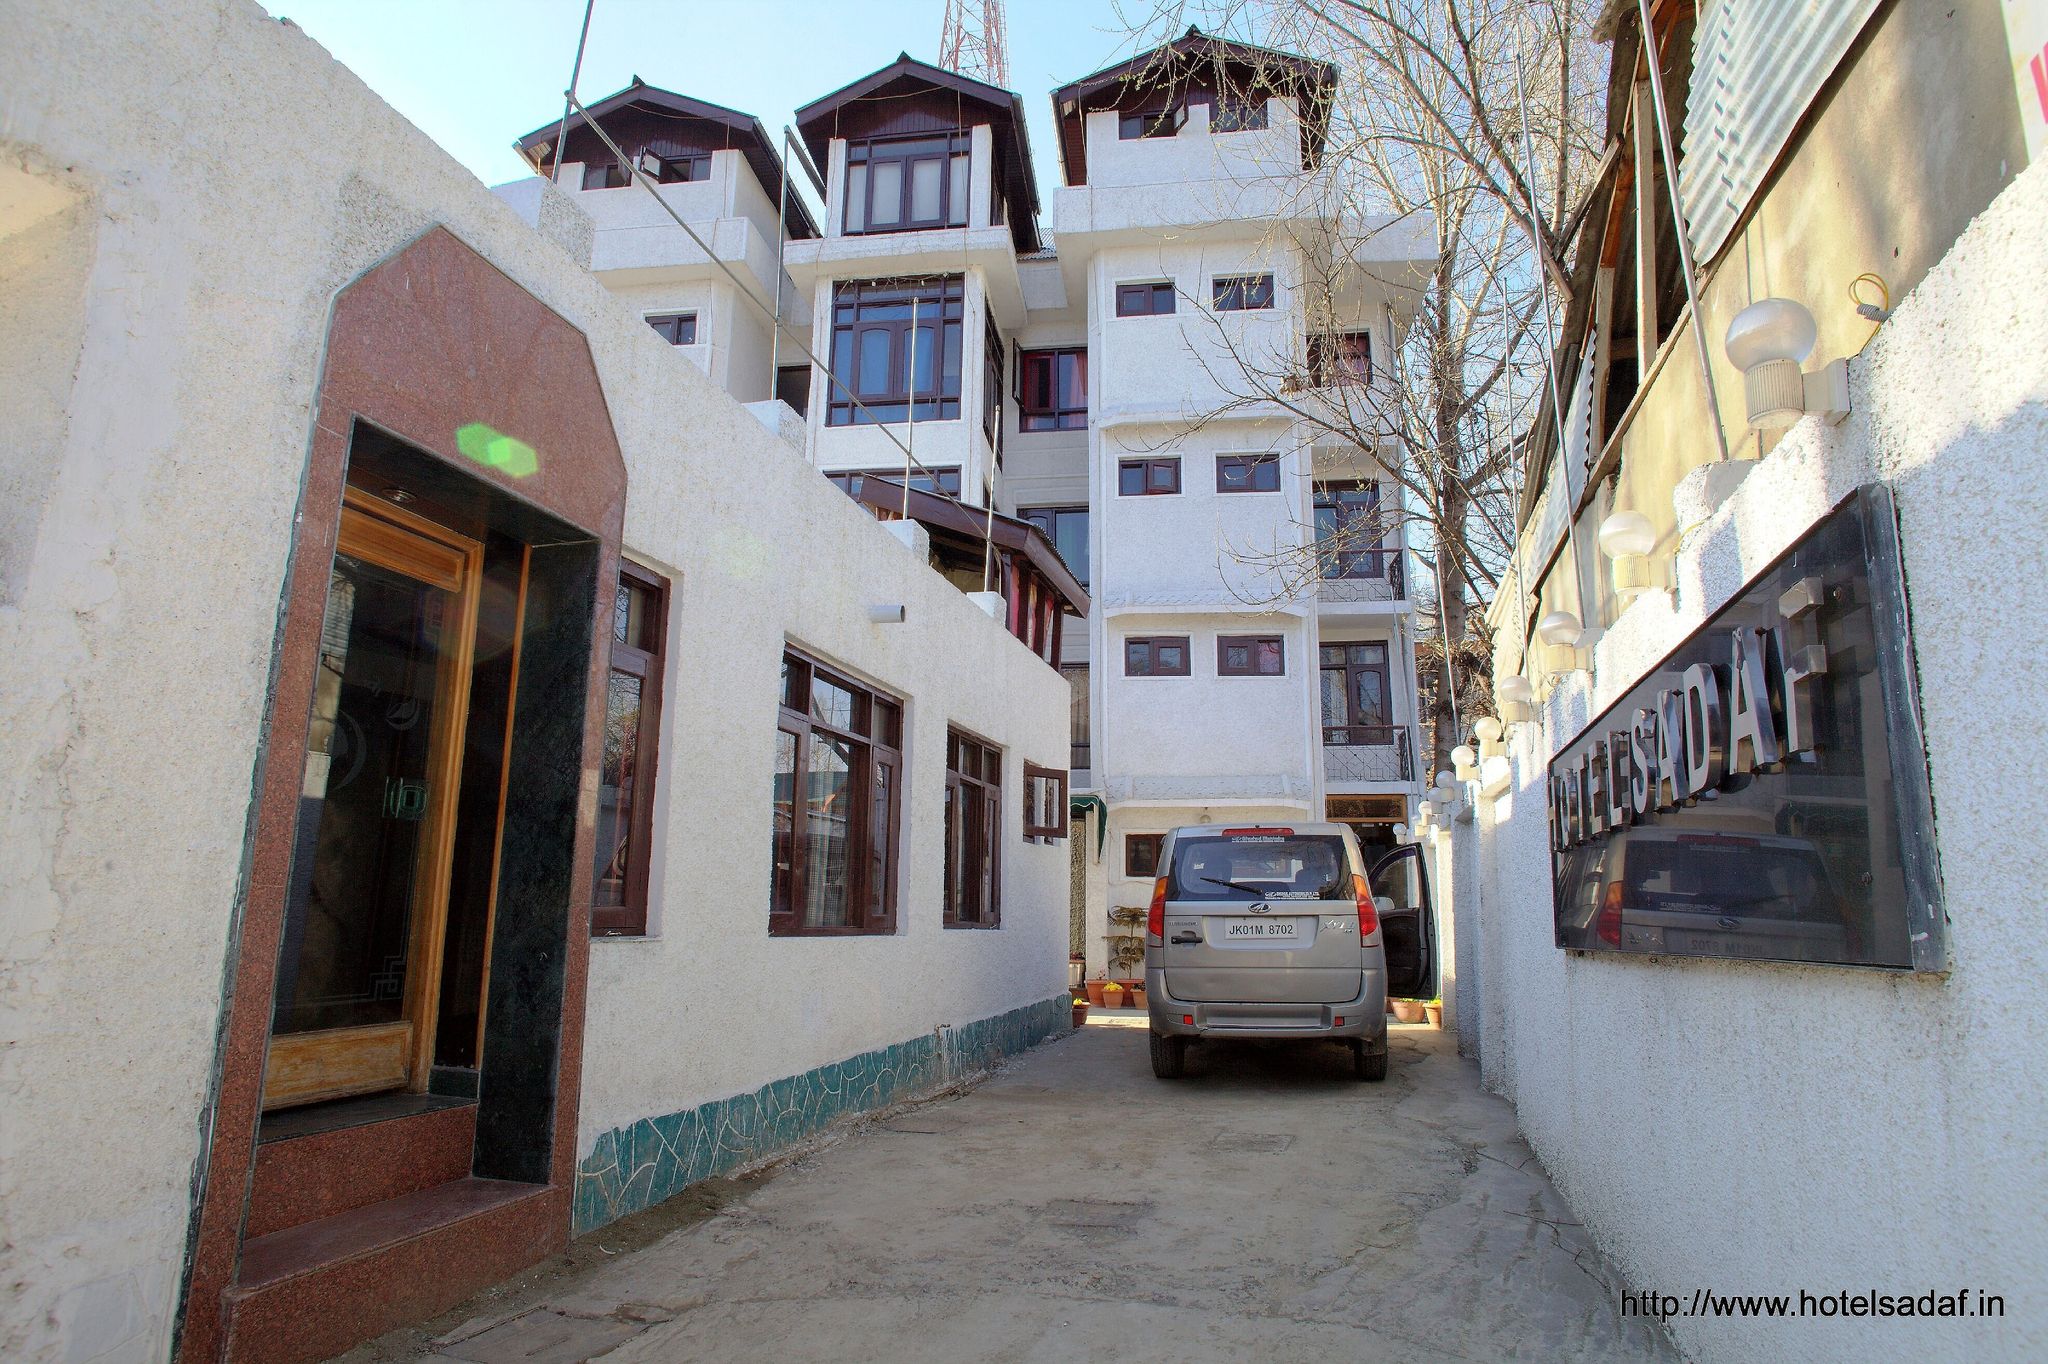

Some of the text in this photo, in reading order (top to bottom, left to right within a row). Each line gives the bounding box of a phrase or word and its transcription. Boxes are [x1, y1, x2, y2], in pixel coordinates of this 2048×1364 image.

[1546, 577, 1828, 852] HOTEL SADAF
[1229, 925, 1294, 935] JK01M 8702
